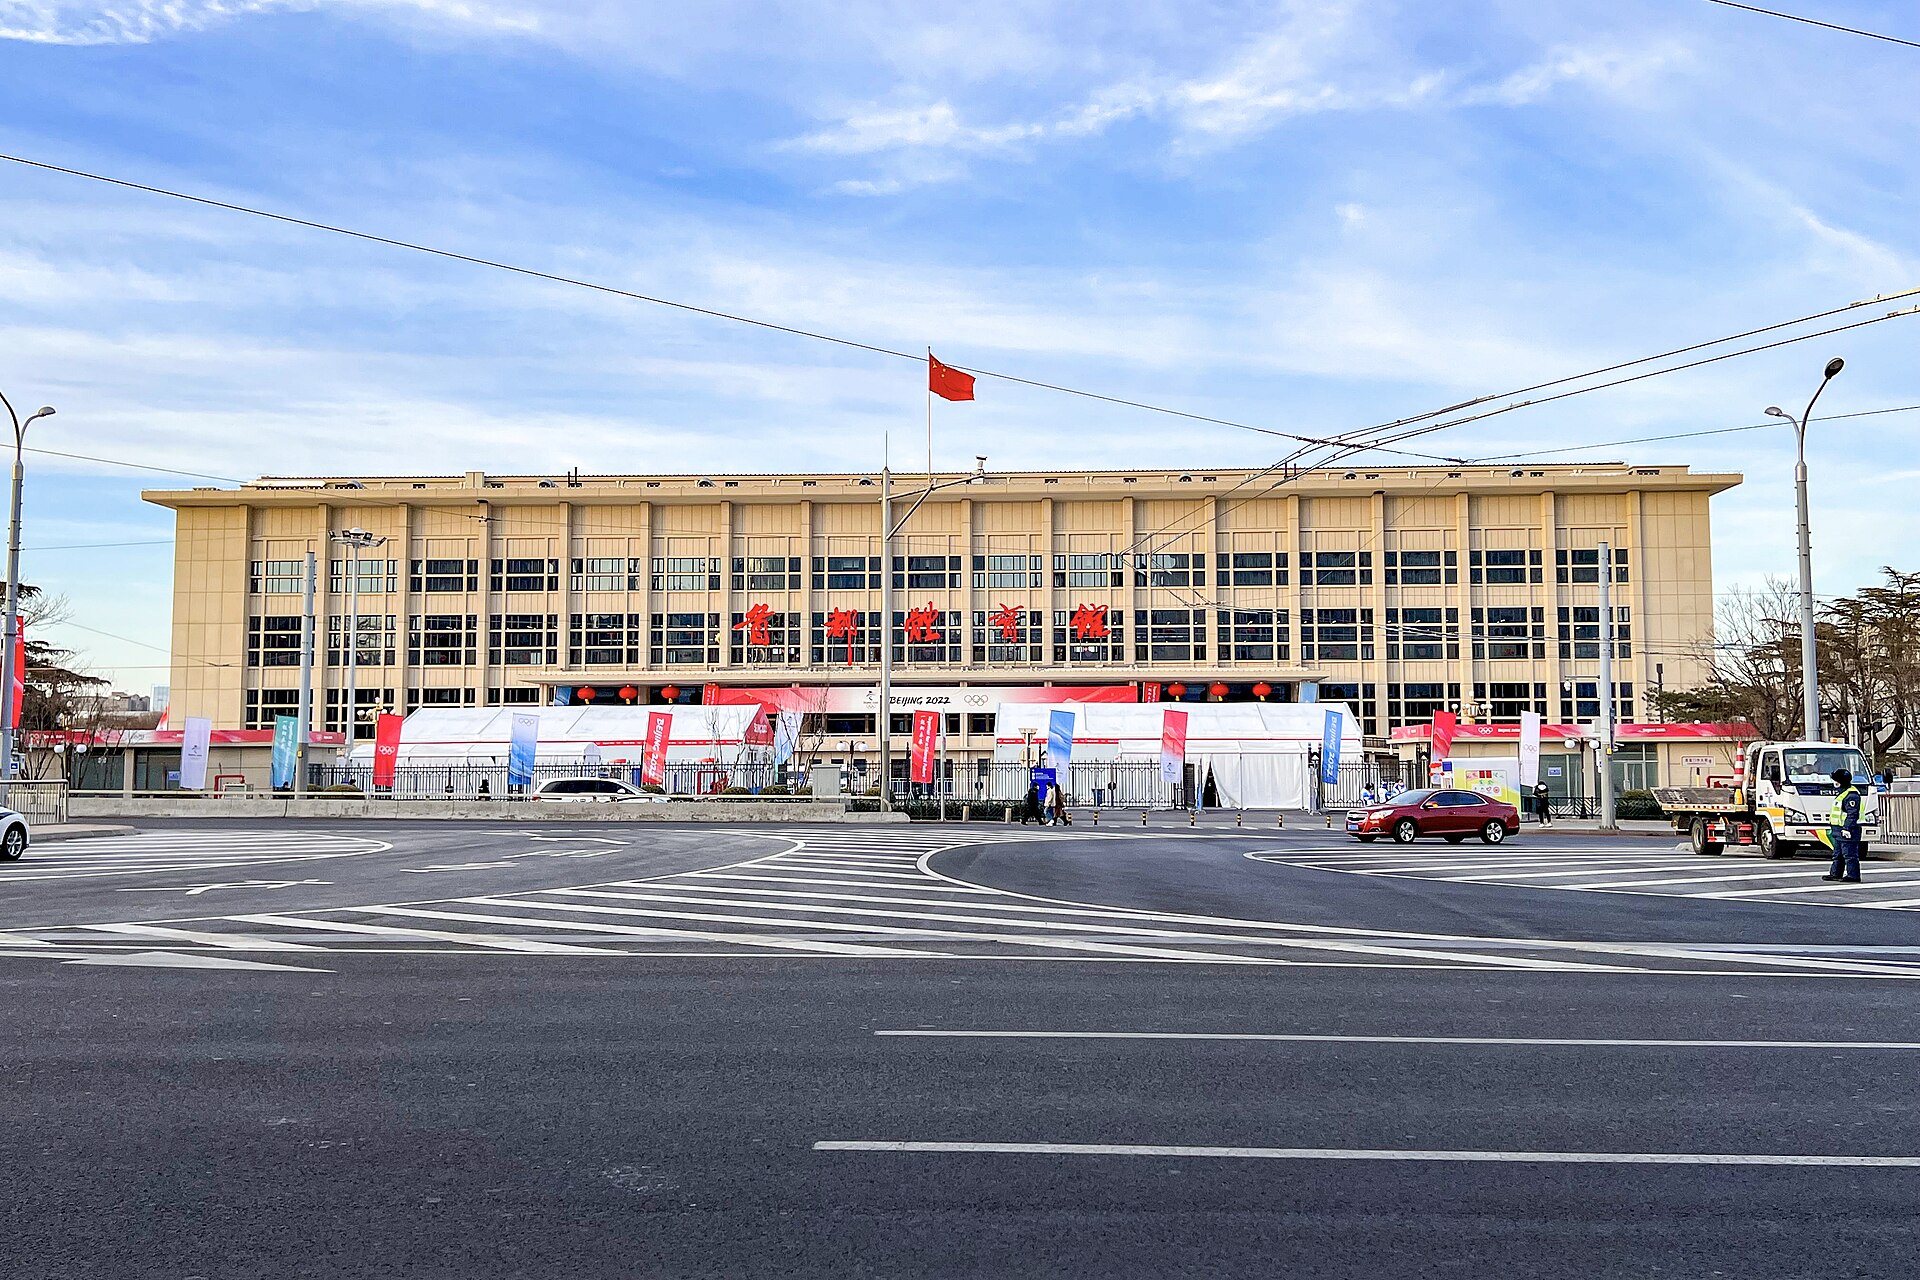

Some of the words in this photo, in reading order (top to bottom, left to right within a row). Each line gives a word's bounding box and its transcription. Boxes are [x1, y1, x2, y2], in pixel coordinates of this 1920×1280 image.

[889, 696, 923, 707] BEIJING
[926, 696, 951, 704] 2022
[653, 718, 664, 752] BEIJING
[1329, 716, 1337, 750] BEIJING
[649, 753, 659, 778] 2022
[1327, 751, 1335, 778] 2022
